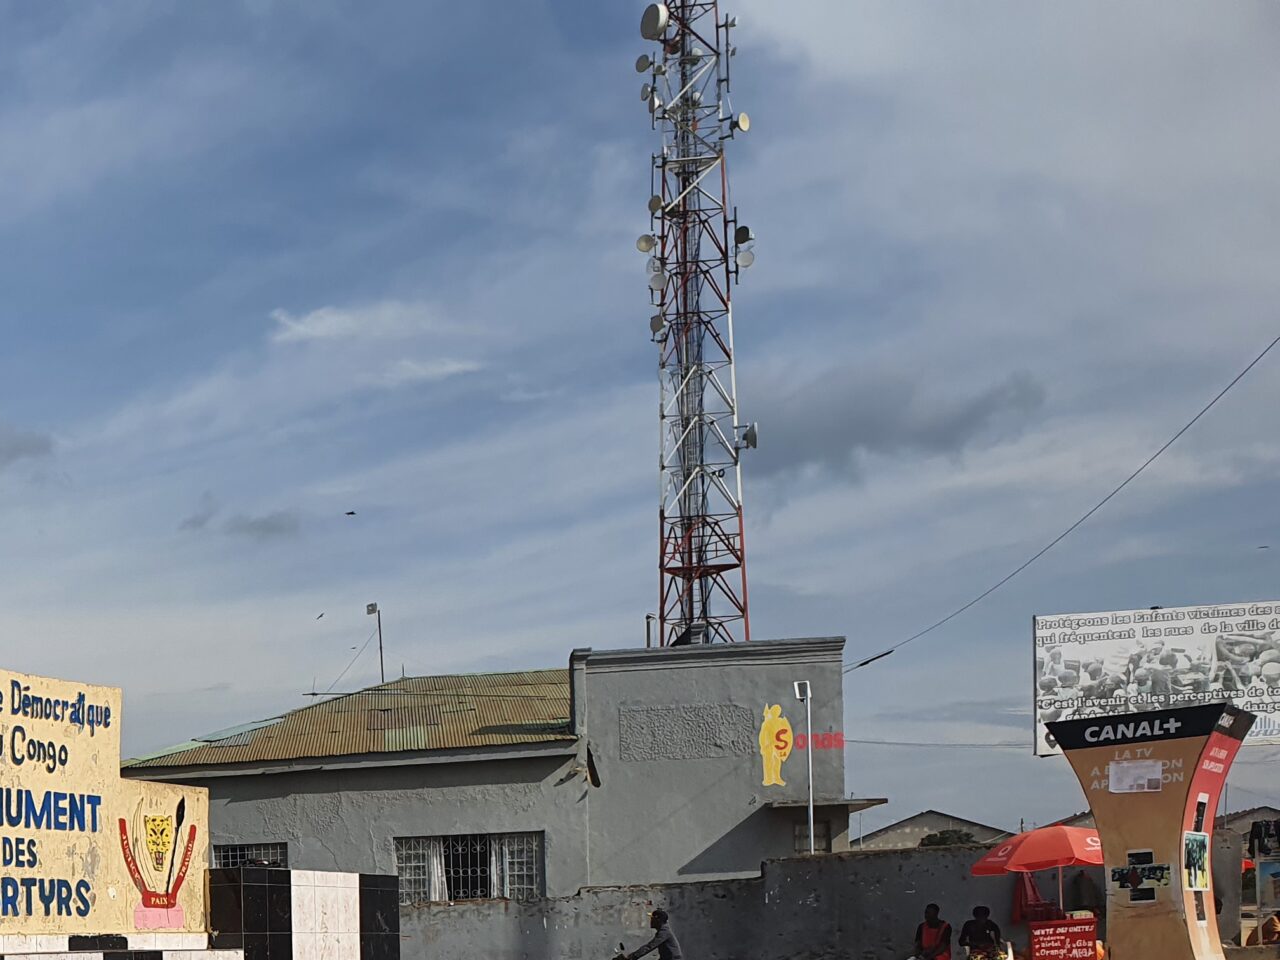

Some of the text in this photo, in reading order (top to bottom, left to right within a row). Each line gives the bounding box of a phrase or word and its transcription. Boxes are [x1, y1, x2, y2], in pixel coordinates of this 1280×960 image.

[1037, 616, 1109, 630] Protégeons
[1111, 613, 1131, 625] les
[1133, 611, 1185, 623] Enfants
[1187, 607, 1246, 620] victimes
[1248, 604, 1272, 616] des
[1036, 632, 1056, 647] qui
[1059, 628, 1136, 644] fréquentent
[1141, 626, 1161, 637] les
[1164, 625, 1193, 636] rues
[1201, 622, 1218, 634] de
[1220, 621, 1234, 632] la
[1236, 619, 1266, 631] ville
[1077, 695, 1127, 707] l'avenir
[1129, 694, 1143, 704] et
[1147, 692, 1166, 703] les
[1169, 687, 1245, 704] perceptives
[1247, 686, 1264, 697] de
[1084, 717, 1182, 742] CANAL+
[10, 725, 68, 774] Congo
[1114, 747, 1154, 760] LA TV
[2, 837, 38, 868] DES
[151, 897, 168, 905] PAIX
